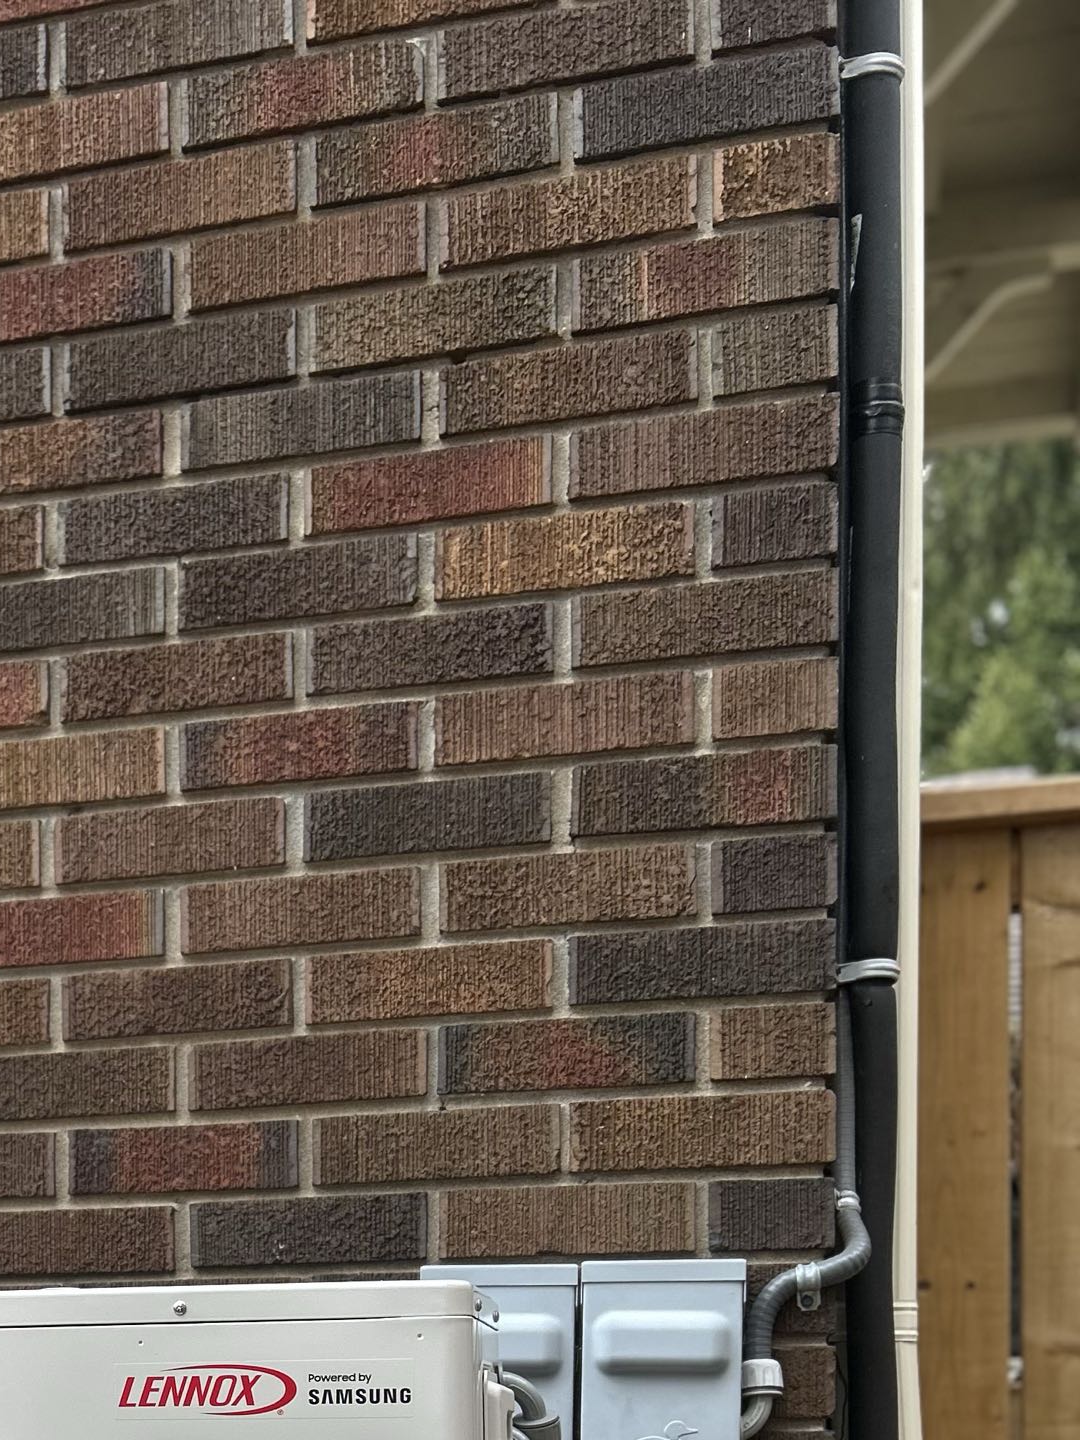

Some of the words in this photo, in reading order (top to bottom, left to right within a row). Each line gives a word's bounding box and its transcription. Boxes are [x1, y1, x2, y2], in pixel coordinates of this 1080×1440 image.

[308, 1373, 356, 1383] Powered
[358, 1373, 372, 1384] by
[118, 1374, 262, 1407] LENNOX
[308, 1388, 412, 1405] SAMSUNG
